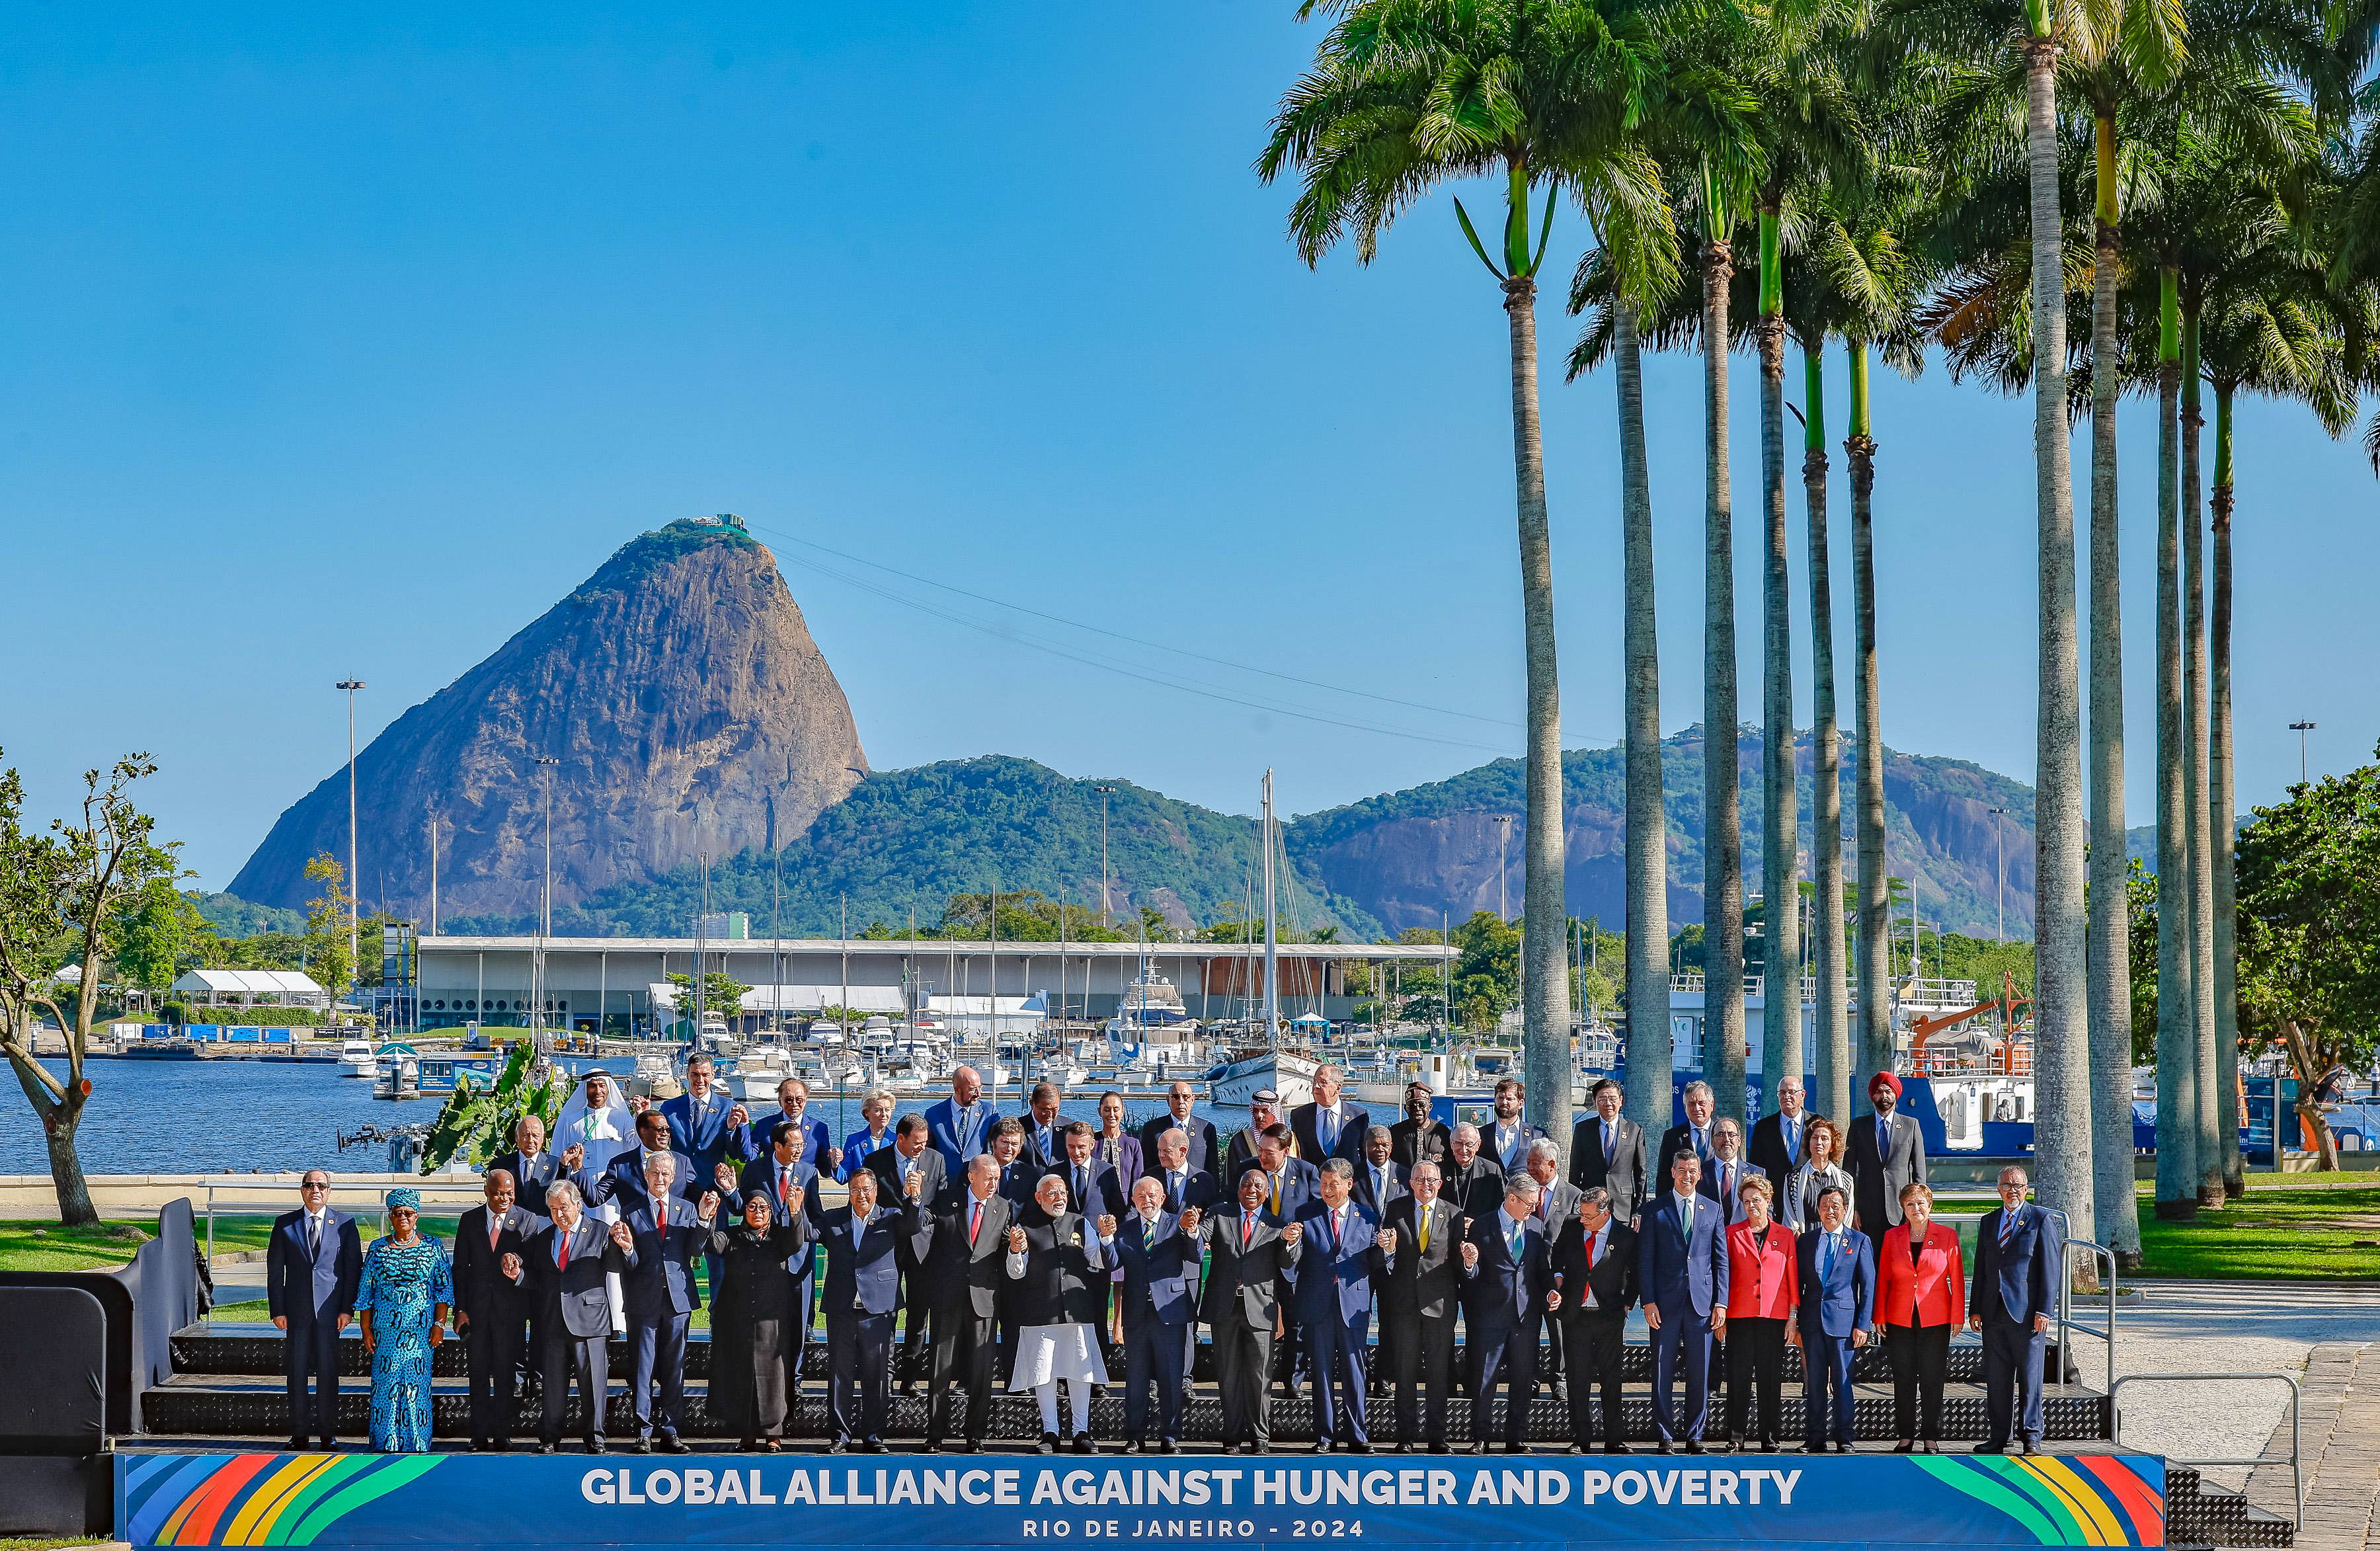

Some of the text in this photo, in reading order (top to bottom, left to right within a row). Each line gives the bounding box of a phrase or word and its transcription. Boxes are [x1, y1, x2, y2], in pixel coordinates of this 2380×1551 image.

[582, 1469, 1803, 1505] GLOBAL ALLIANCE AGAINST HUNGER AND POVERTY
[1023, 1520, 1070, 1537] RIO
[1086, 1520, 1119, 1537] DE
[1132, 1520, 1255, 1537] JANEIRO
[1292, 1520, 1363, 1537] 2024
